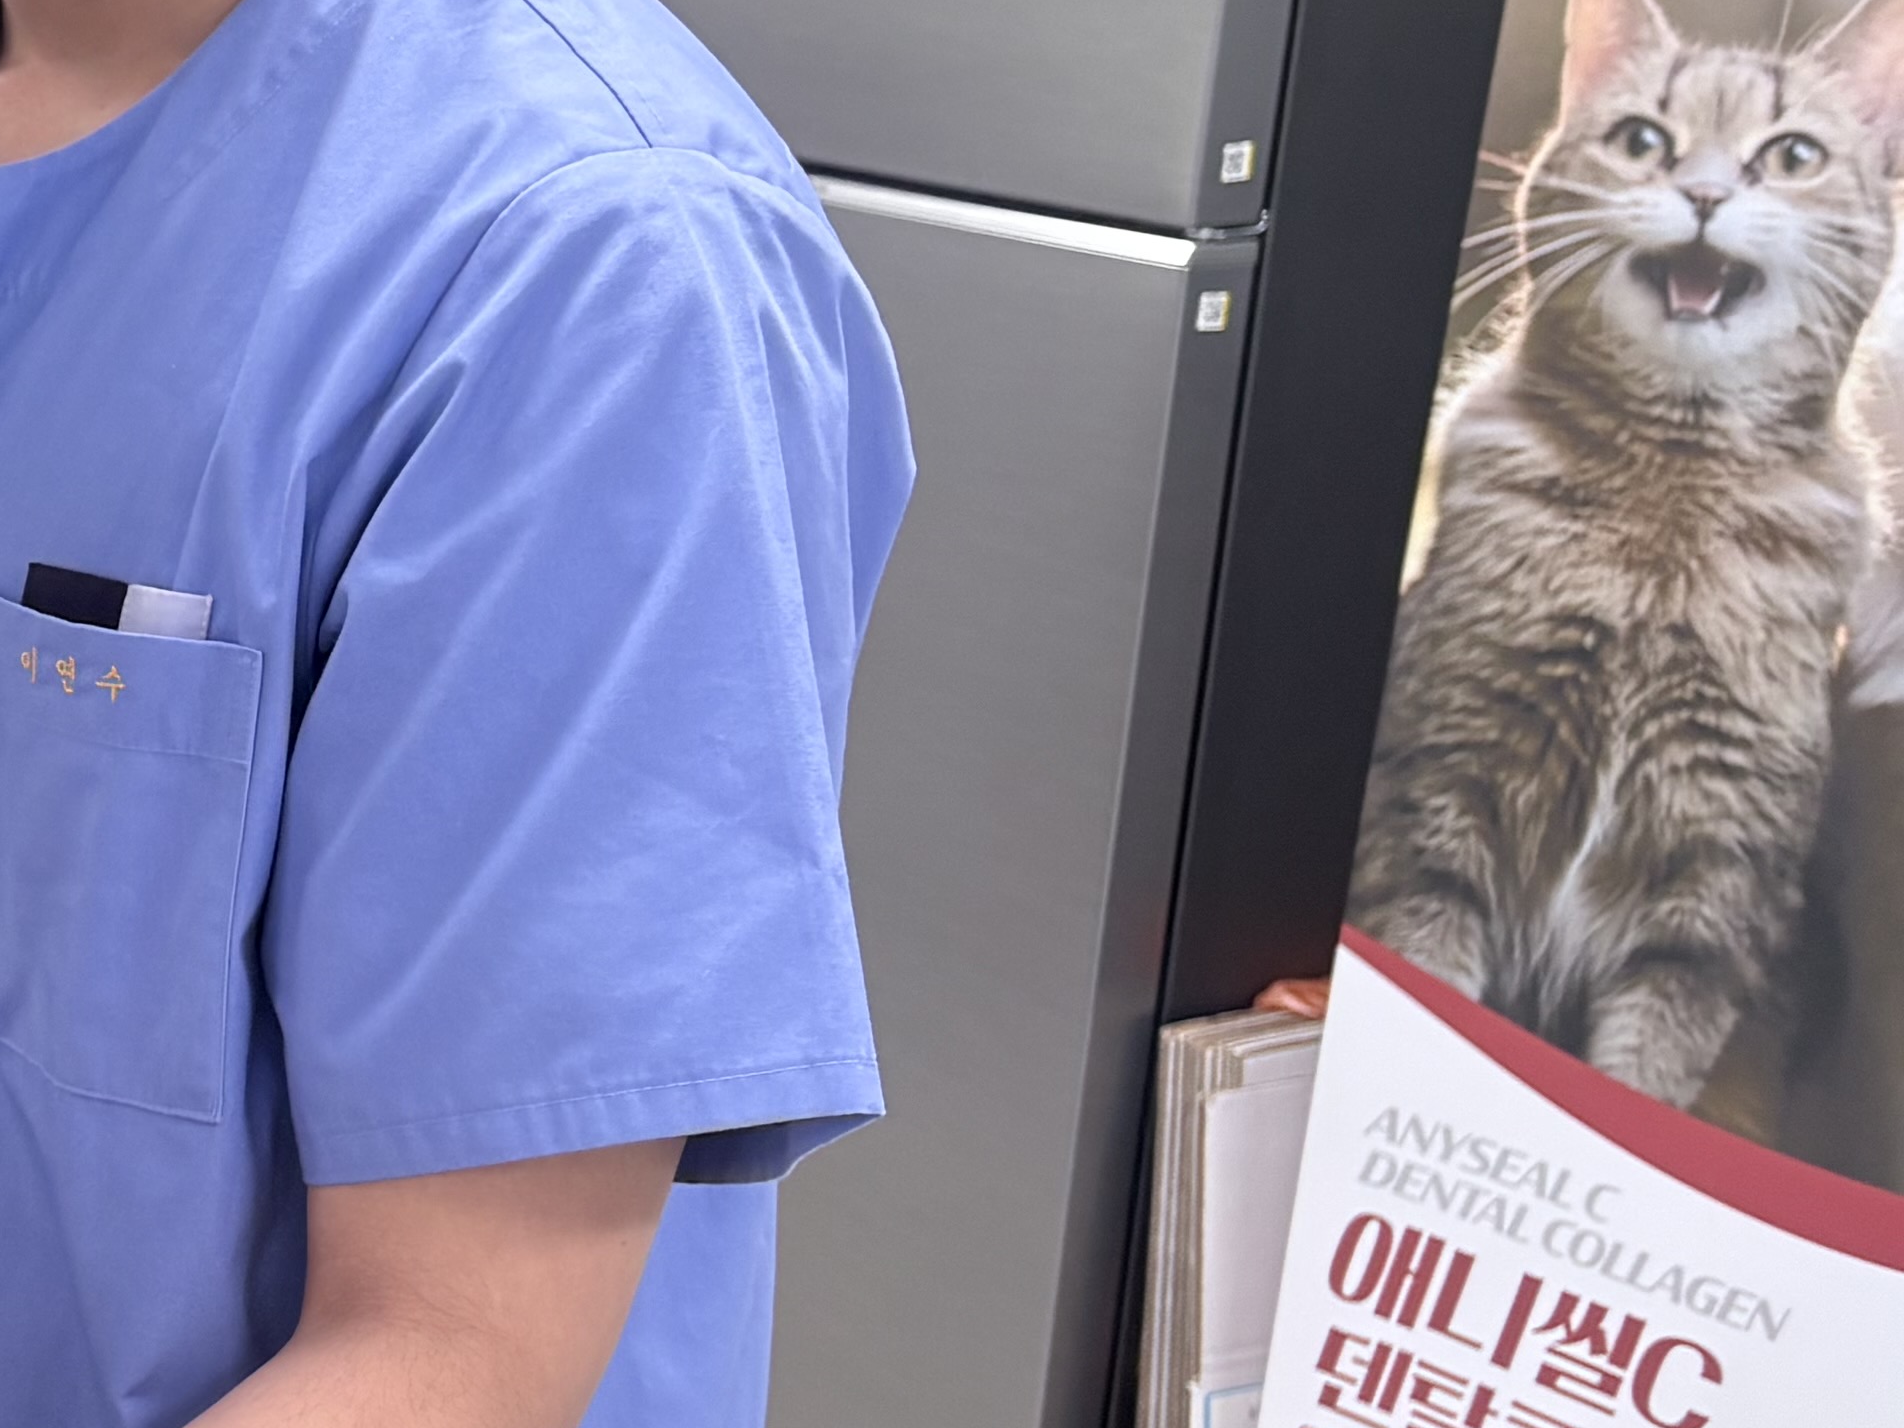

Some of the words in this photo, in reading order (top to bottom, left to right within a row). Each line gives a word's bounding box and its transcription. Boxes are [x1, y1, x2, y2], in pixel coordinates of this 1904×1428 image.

[1363, 1106, 1574, 1211] ANYSEAL
[1584, 1184, 1622, 1225] C
[1357, 1150, 1534, 1245] DENTAL
[1542, 1218, 1793, 1343] COLLAGEN
